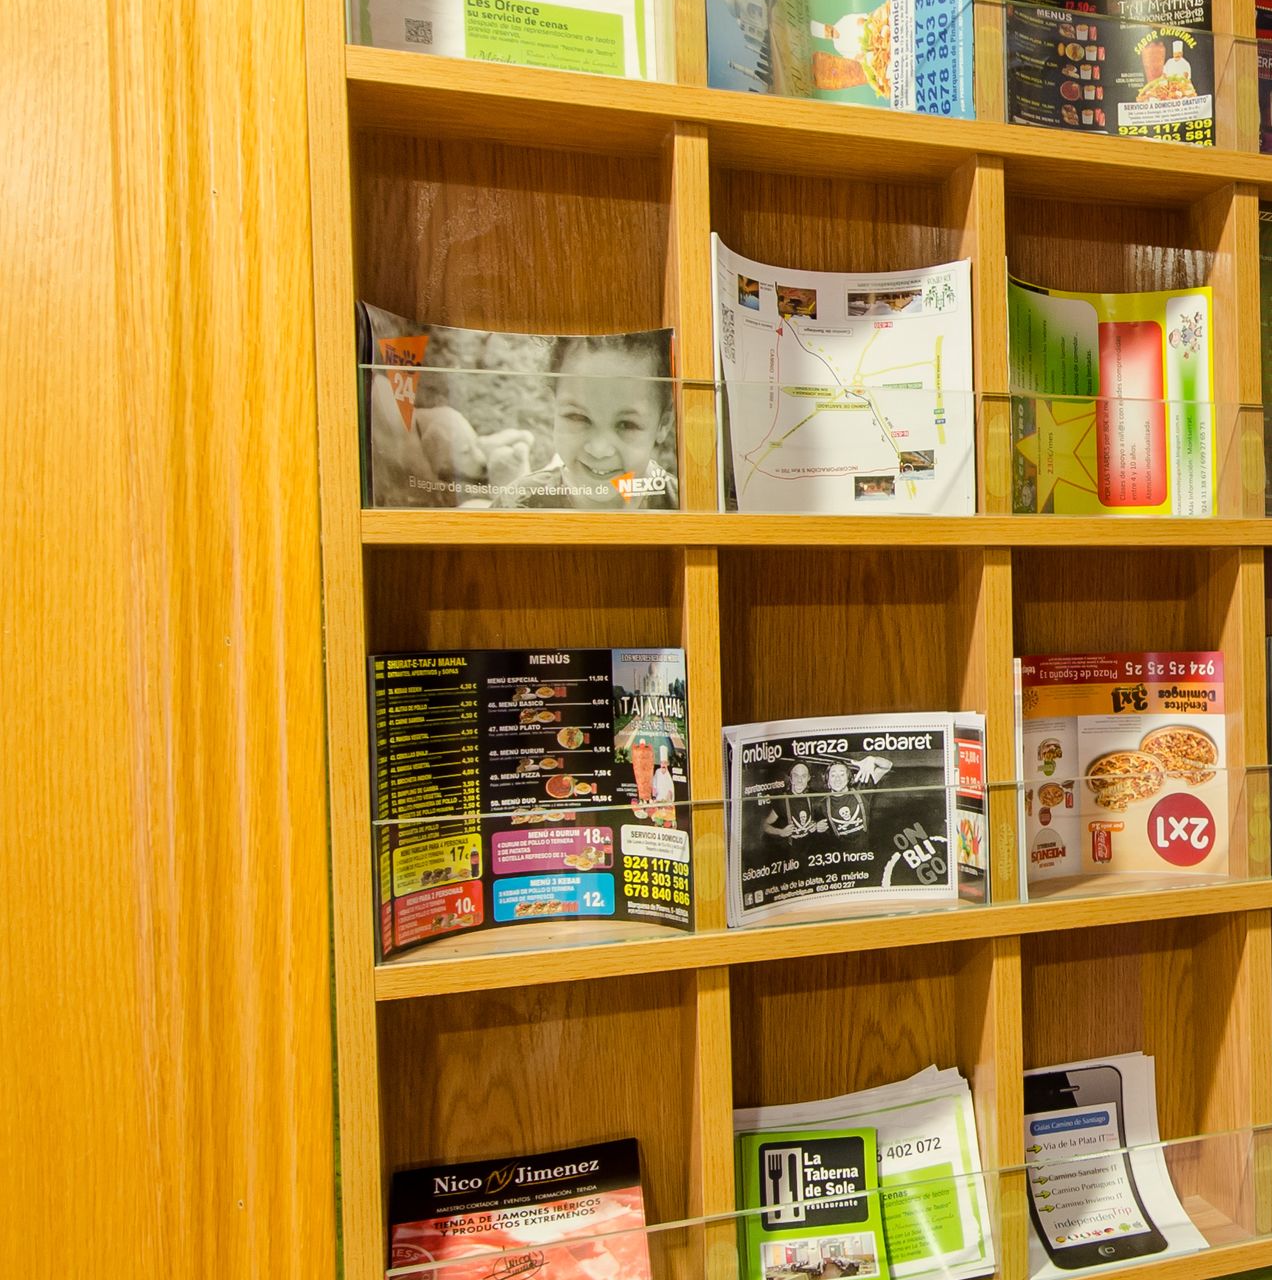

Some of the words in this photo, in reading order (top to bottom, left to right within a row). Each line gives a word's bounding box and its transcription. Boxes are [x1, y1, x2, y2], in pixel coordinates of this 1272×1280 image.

[495, 0, 540, 16] Ofrece
[482, 12, 521, 23] servicio
[525, 18, 536, 26] de
[540, 21, 569, 31] cenas
[927, 16, 936, 61] 303
[939, 13, 949, 58] 840
[1134, 30, 1158, 55] SABOR
[939, 68, 950, 114] 678
[1119, 126, 1148, 135] 924
[1154, 123, 1180, 133] 117
[1186, 118, 1212, 130] 309
[395, 373, 415, 404] 24
[1130, 461, 1136, 469] 10
[418, 480, 446, 493] seguro
[448, 482, 462, 493] de
[464, 481, 526, 497] asistencia
[530, 483, 592, 497] veterinaria
[596, 484, 609, 495] de
[619, 476, 665, 493] NEXO
[529, 653, 570, 664] MENÚS
[1040, 670, 1047, 678] 13
[1049, 669, 1078, 680] España
[1080, 671, 1091, 679] de
[1094, 669, 1118, 679] Plaza
[1125, 661, 1142, 675] 25
[1148, 661, 1164, 675] 25
[1169, 661, 1185, 675] 25
[1189, 660, 1215, 675] 924
[1158, 686, 1216, 702] Domingos
[648, 698, 683, 718] MAHAL
[1164, 701, 1208, 712] Benditos
[742, 742, 782, 763] onbligo
[792, 738, 848, 756] terraza
[863, 733, 932, 752] cabaret
[893, 821, 928, 851] ON
[1156, 816, 1208, 850] 2x1
[808, 852, 840, 867] 23,30
[843, 851, 874, 862] horas
[903, 838, 937, 871] BLI
[623, 856, 648, 869] 924
[651, 858, 670, 872] 117
[673, 862, 689, 876] 309
[771, 861, 782, 874] 27
[783, 858, 799, 874] julio
[916, 857, 947, 885] GO
[623, 870, 649, 883] 924
[652, 872, 671, 887] 303
[673, 876, 688, 891] 581
[826, 874, 838, 883] 26
[624, 884, 649, 898] 678
[652, 886, 671, 901] 840
[673, 891, 690, 906] 686
[887, 1142, 913, 1160] 402
[916, 1137, 942, 1155] 072
[1058, 1140, 1067, 1149] de
[1079, 1136, 1097, 1145] Plata
[804, 1152, 821, 1166] La
[433, 1176, 482, 1195] Nico
[514, 1159, 600, 1185] Jimenez
[804, 1166, 859, 1181] Taberna
[1048, 1172, 1077, 1181] Camino
[806, 1183, 822, 1197] de
[825, 1181, 856, 1197] Sole
[882, 1190, 908, 1201] cenas
[1051, 1186, 1080, 1195] Camino
[806, 1199, 859, 1211] restaurante
[1056, 1200, 1084, 1209] Camino
[434, 1217, 475, 1230] TIENDA
[480, 1215, 493, 1223] DE
[496, 1206, 550, 1221] JAMONES
[553, 1197, 601, 1213] IBÉRICOS
[452, 1219, 520, 1236] PRODUCTOS
